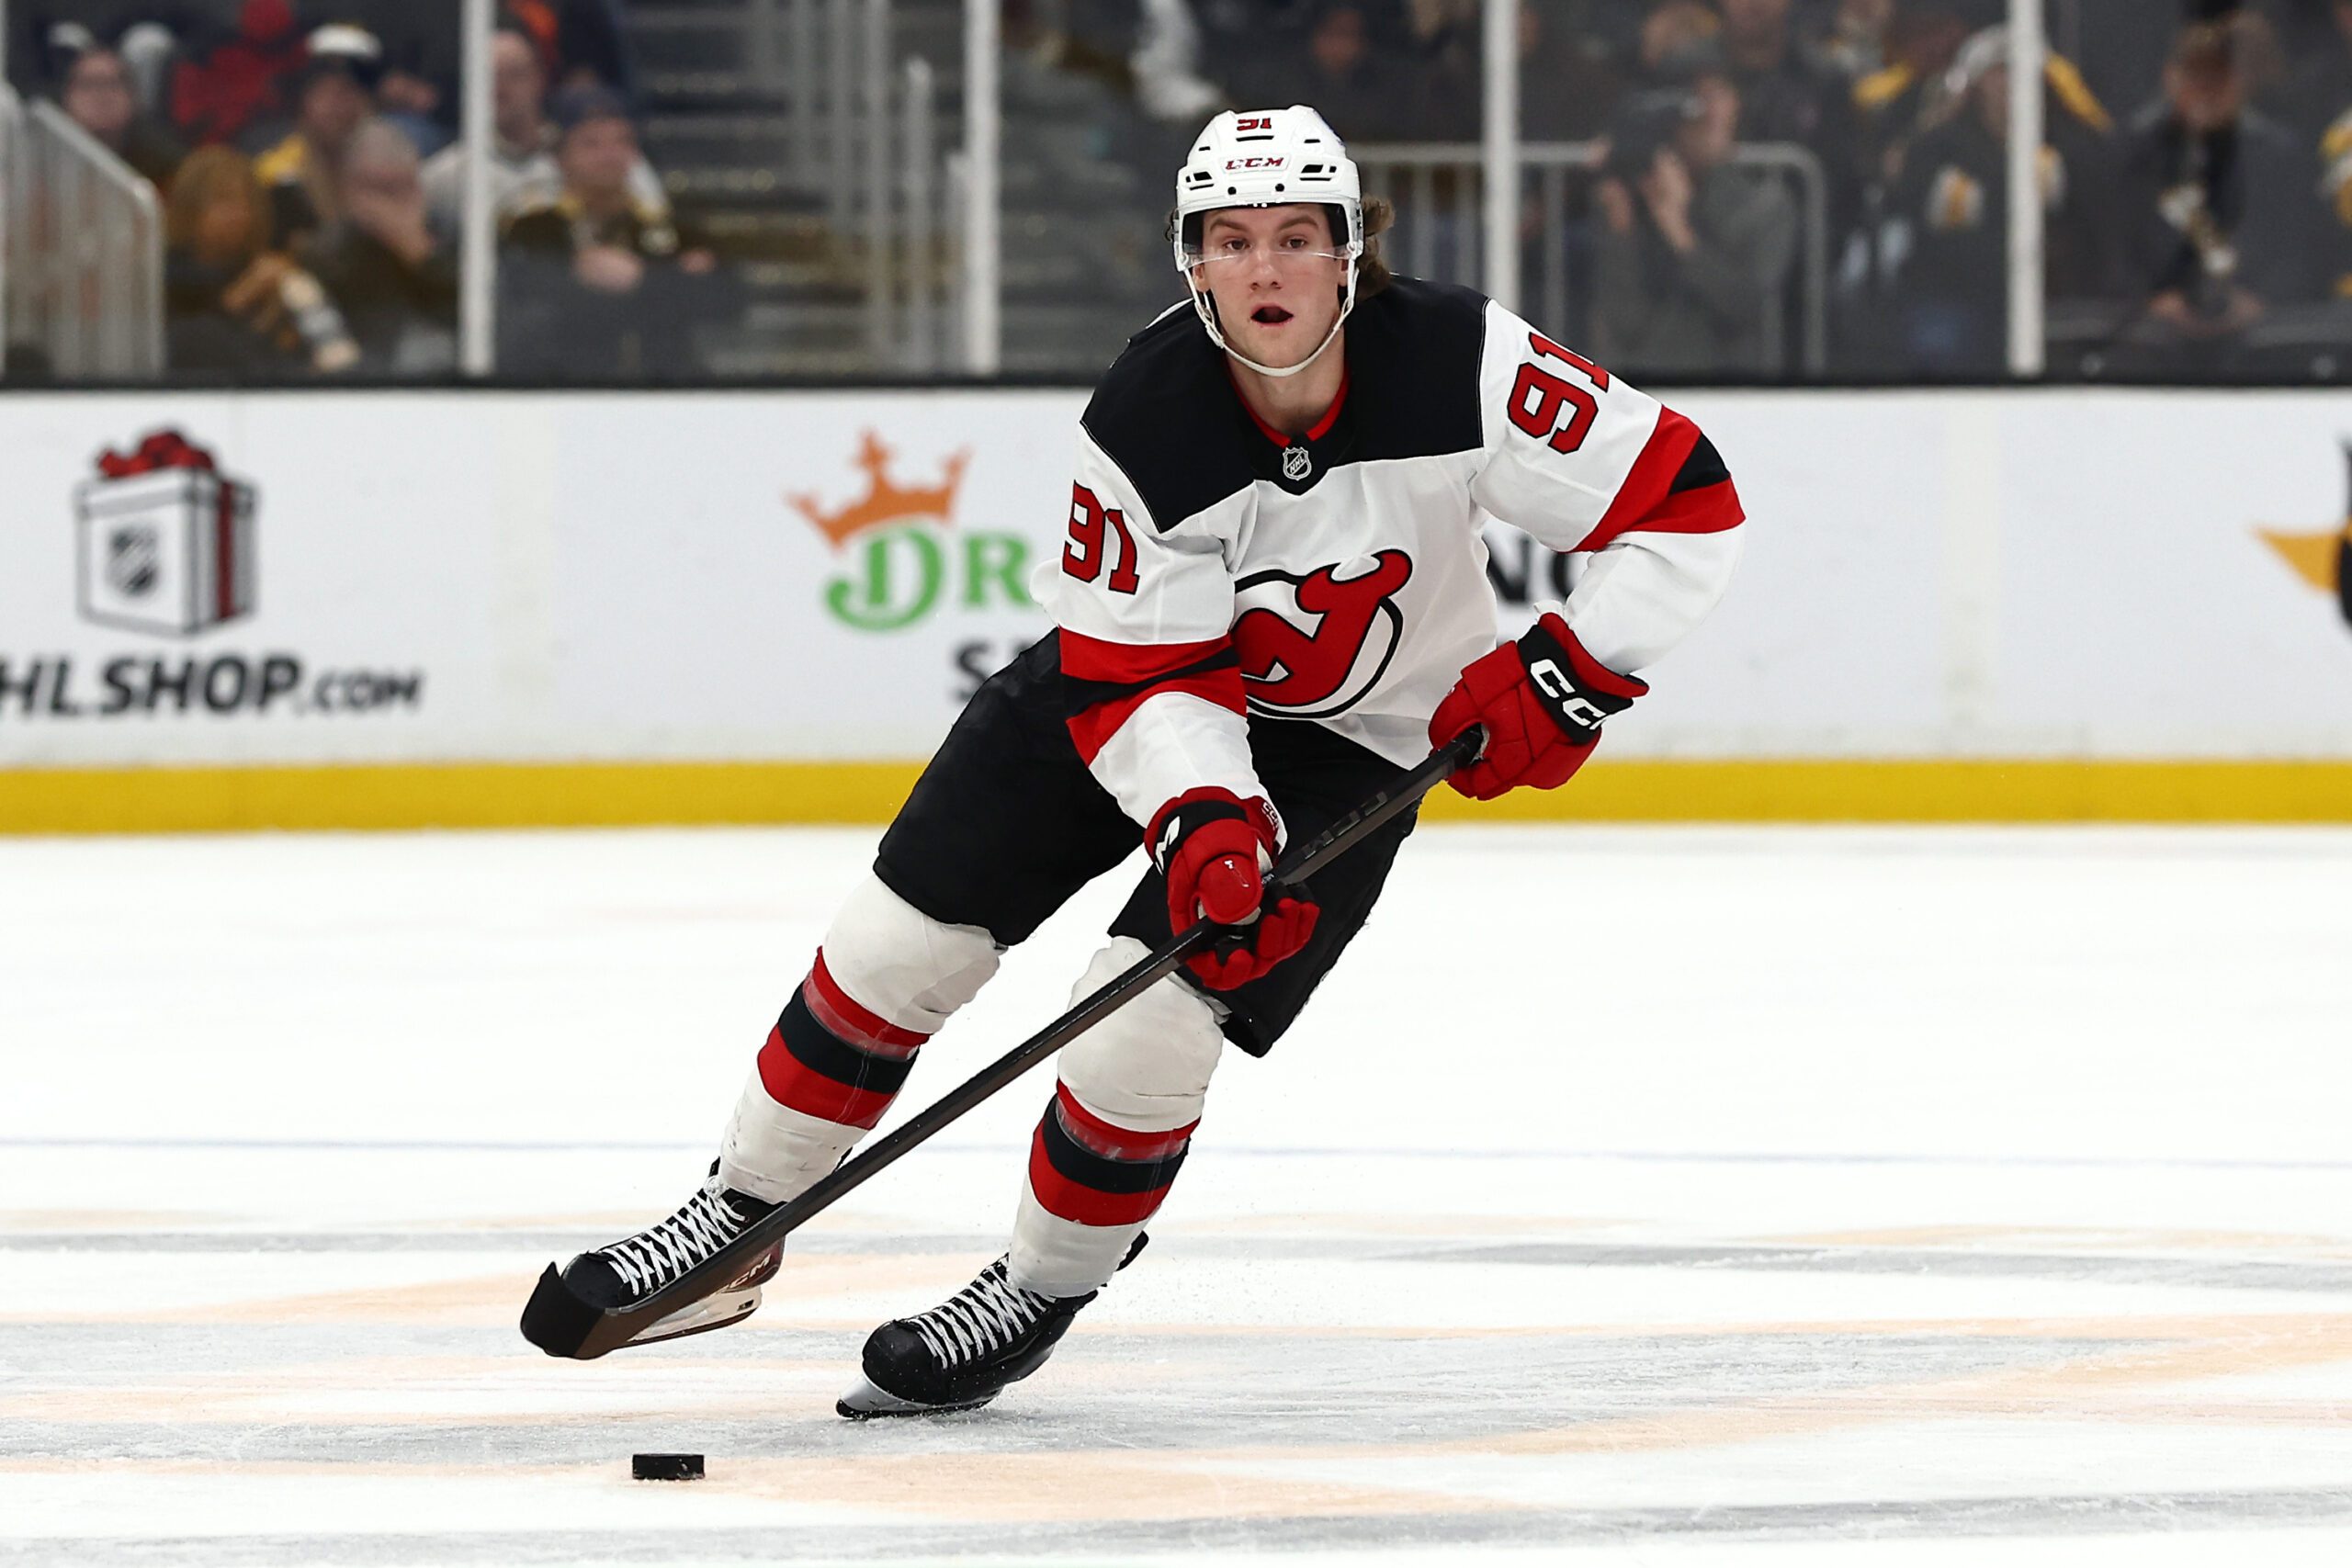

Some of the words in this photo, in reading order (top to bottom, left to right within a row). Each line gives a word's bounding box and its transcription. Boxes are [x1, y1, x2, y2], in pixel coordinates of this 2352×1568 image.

[1226, 157, 1283, 170] CCM
[1507, 332, 1609, 455] 91
[1062, 479, 1139, 594] 91
[1530, 659, 1607, 730] CC
